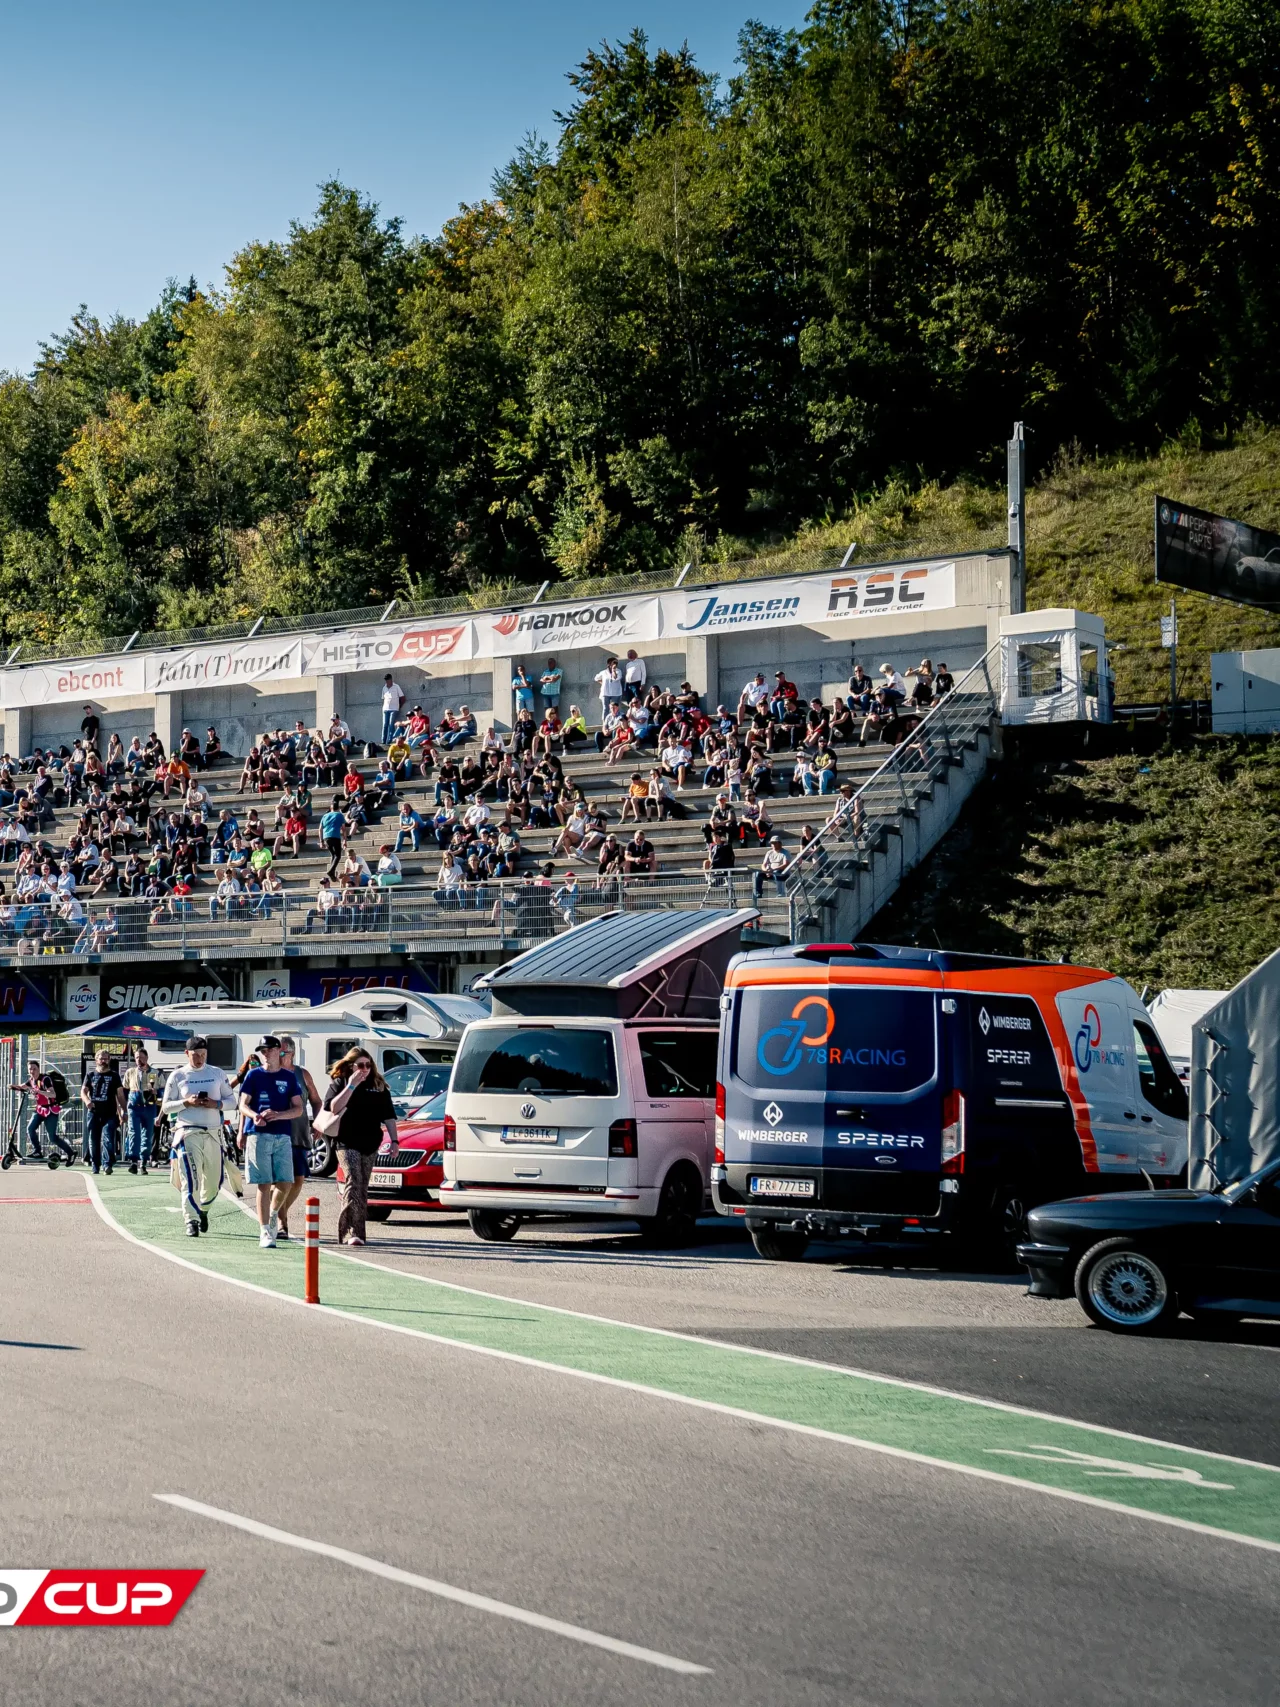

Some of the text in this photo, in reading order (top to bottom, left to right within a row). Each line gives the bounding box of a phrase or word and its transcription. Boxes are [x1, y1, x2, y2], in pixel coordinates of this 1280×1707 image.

[677, 596, 800, 631] Jansen
[708, 610, 798, 626] COMPETITION
[852, 606, 888, 615] Service
[323, 633, 454, 663] HISTO CUP
[57, 667, 124, 693] ebcont
[70, 993, 96, 1003] FUCHS
[256, 988, 286, 997] FUCHS
[993, 1015, 1031, 1030] WIMBERGER
[987, 1049, 1031, 1065] SPERER
[738, 1130, 807, 1143] WIMBERGER
[837, 1133, 924, 1148] SPERER
